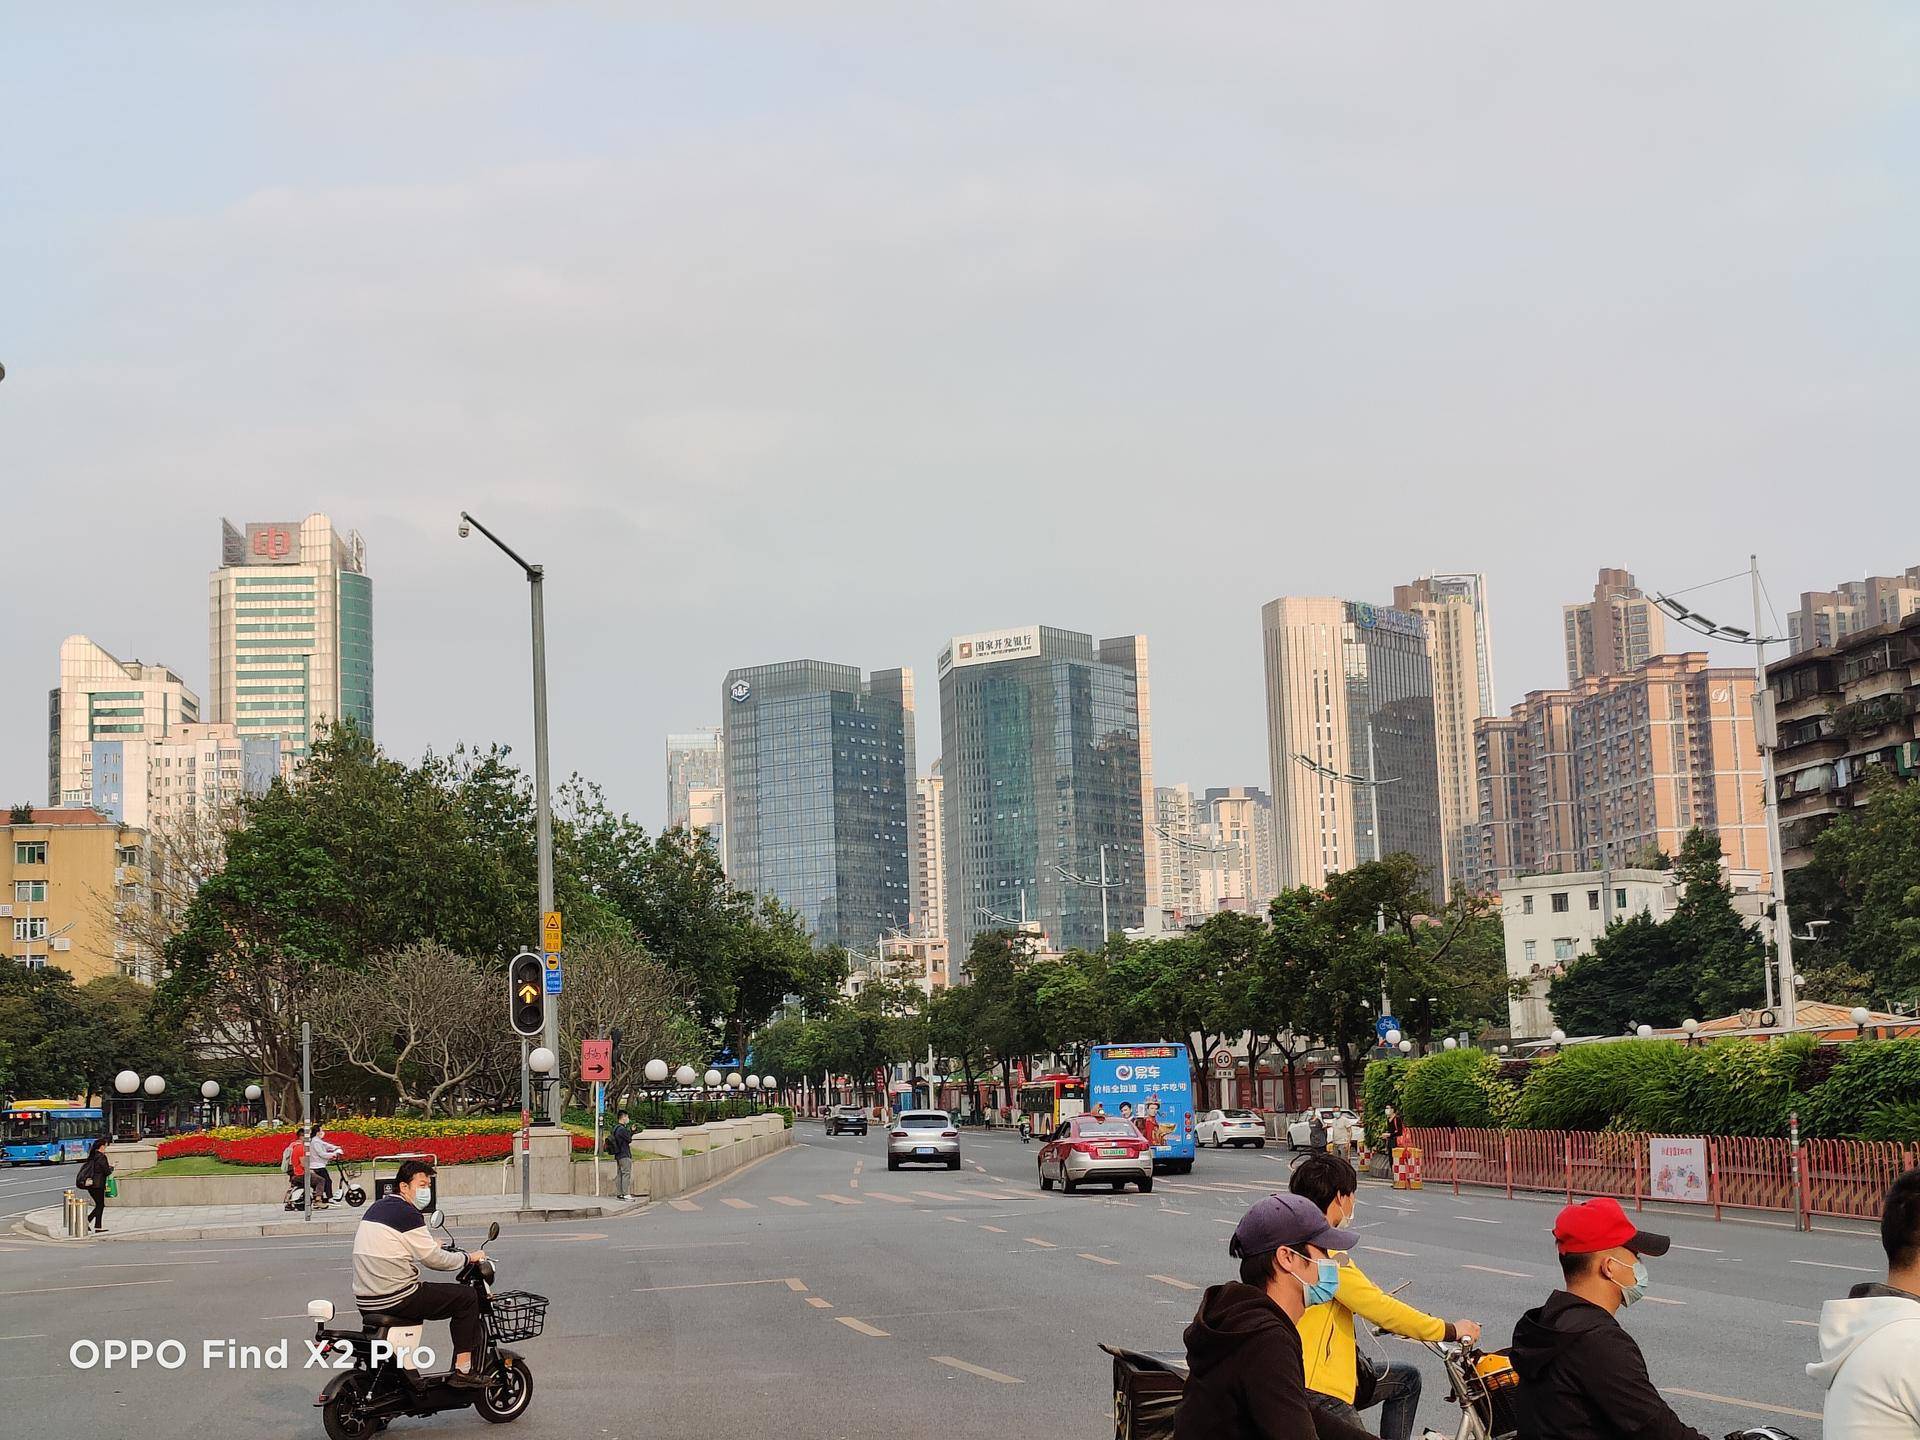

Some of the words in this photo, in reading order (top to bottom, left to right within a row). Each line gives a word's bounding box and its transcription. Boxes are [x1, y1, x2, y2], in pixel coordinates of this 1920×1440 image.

[975, 634, 1032, 652] 国家开发银行
[1217, 1055, 1230, 1064] 60
[1135, 1065, 1160, 1080] 易车
[1094, 1084, 1137, 1094] 价格全知道
